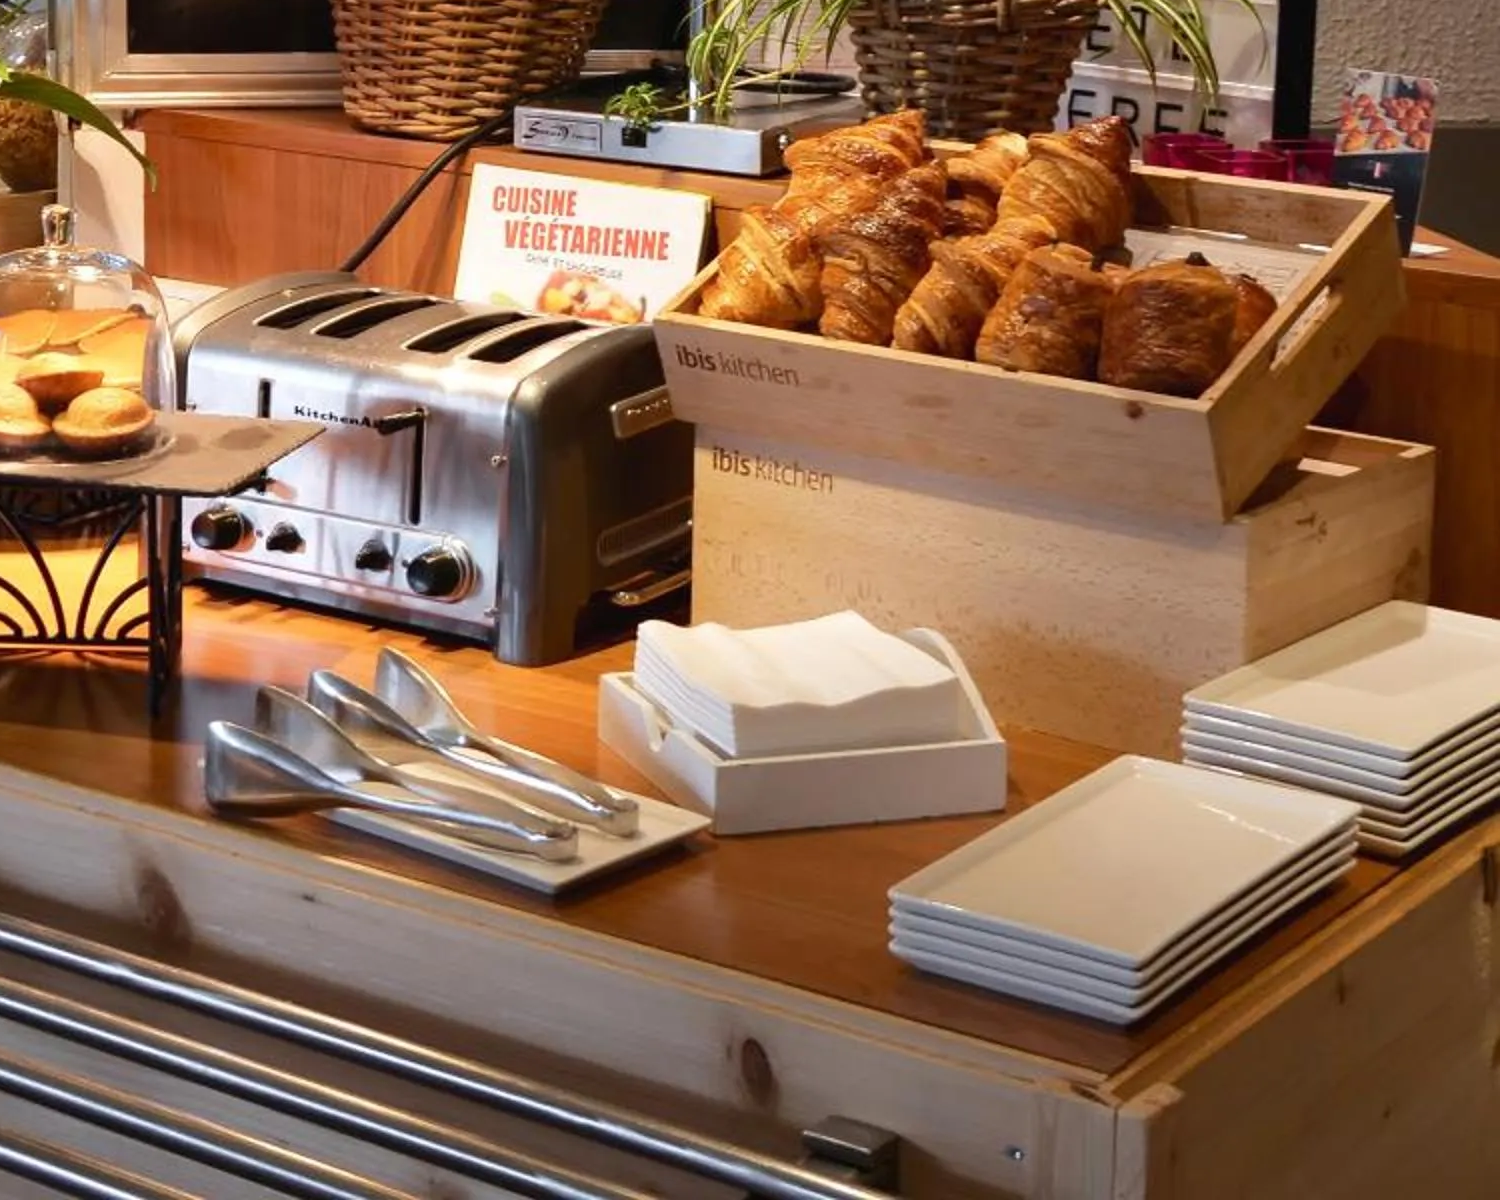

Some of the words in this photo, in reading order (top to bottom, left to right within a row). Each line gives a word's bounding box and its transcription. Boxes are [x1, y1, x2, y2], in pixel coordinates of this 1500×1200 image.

[492, 185, 578, 217] CUISINE
[504, 215, 671, 262] VÉGÉTARIENNE
[674, 343, 717, 372] ibis
[718, 351, 800, 388] kitchen
[711, 445, 751, 478] ibis
[754, 455, 835, 494] kitchen
